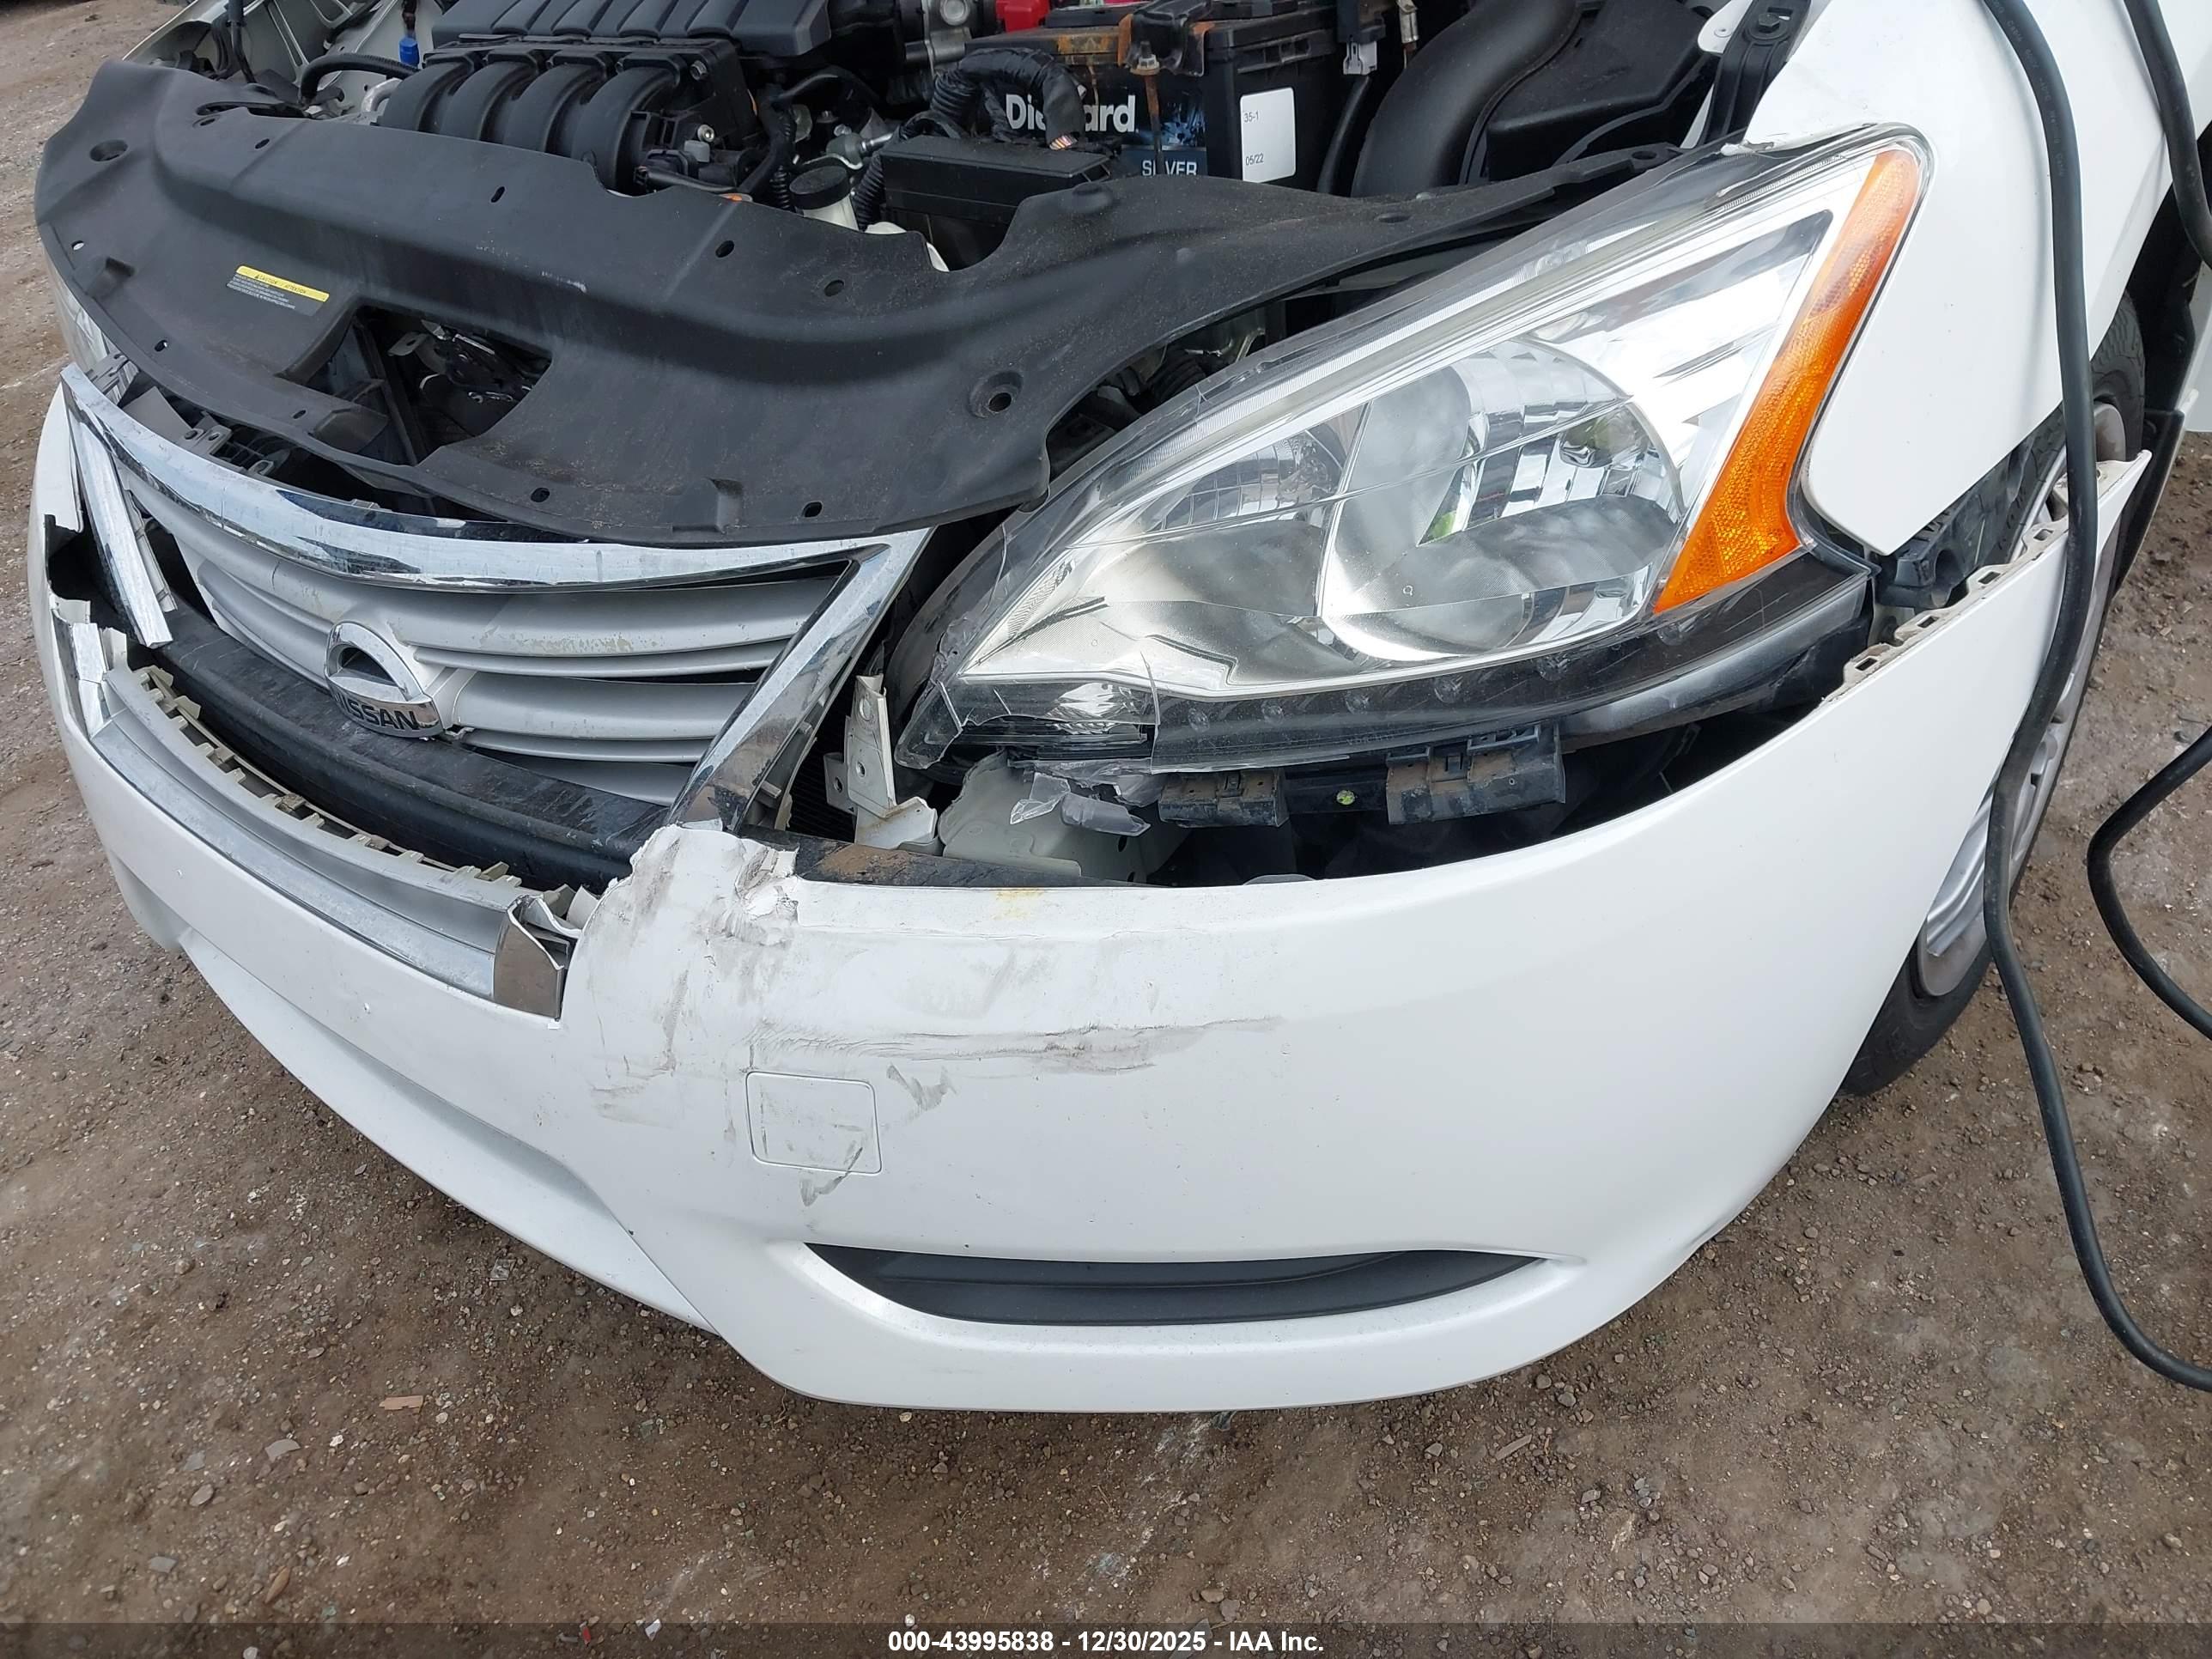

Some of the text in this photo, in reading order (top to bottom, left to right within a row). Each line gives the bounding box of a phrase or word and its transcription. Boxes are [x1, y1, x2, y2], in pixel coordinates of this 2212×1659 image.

[1006, 94, 1136, 133] Dieard
[1244, 111, 1259, 123] 35-1
[1245, 152, 1264, 166] 05/22
[1142, 160, 1197, 177] SIVER
[333, 691, 420, 731] NISSAN
